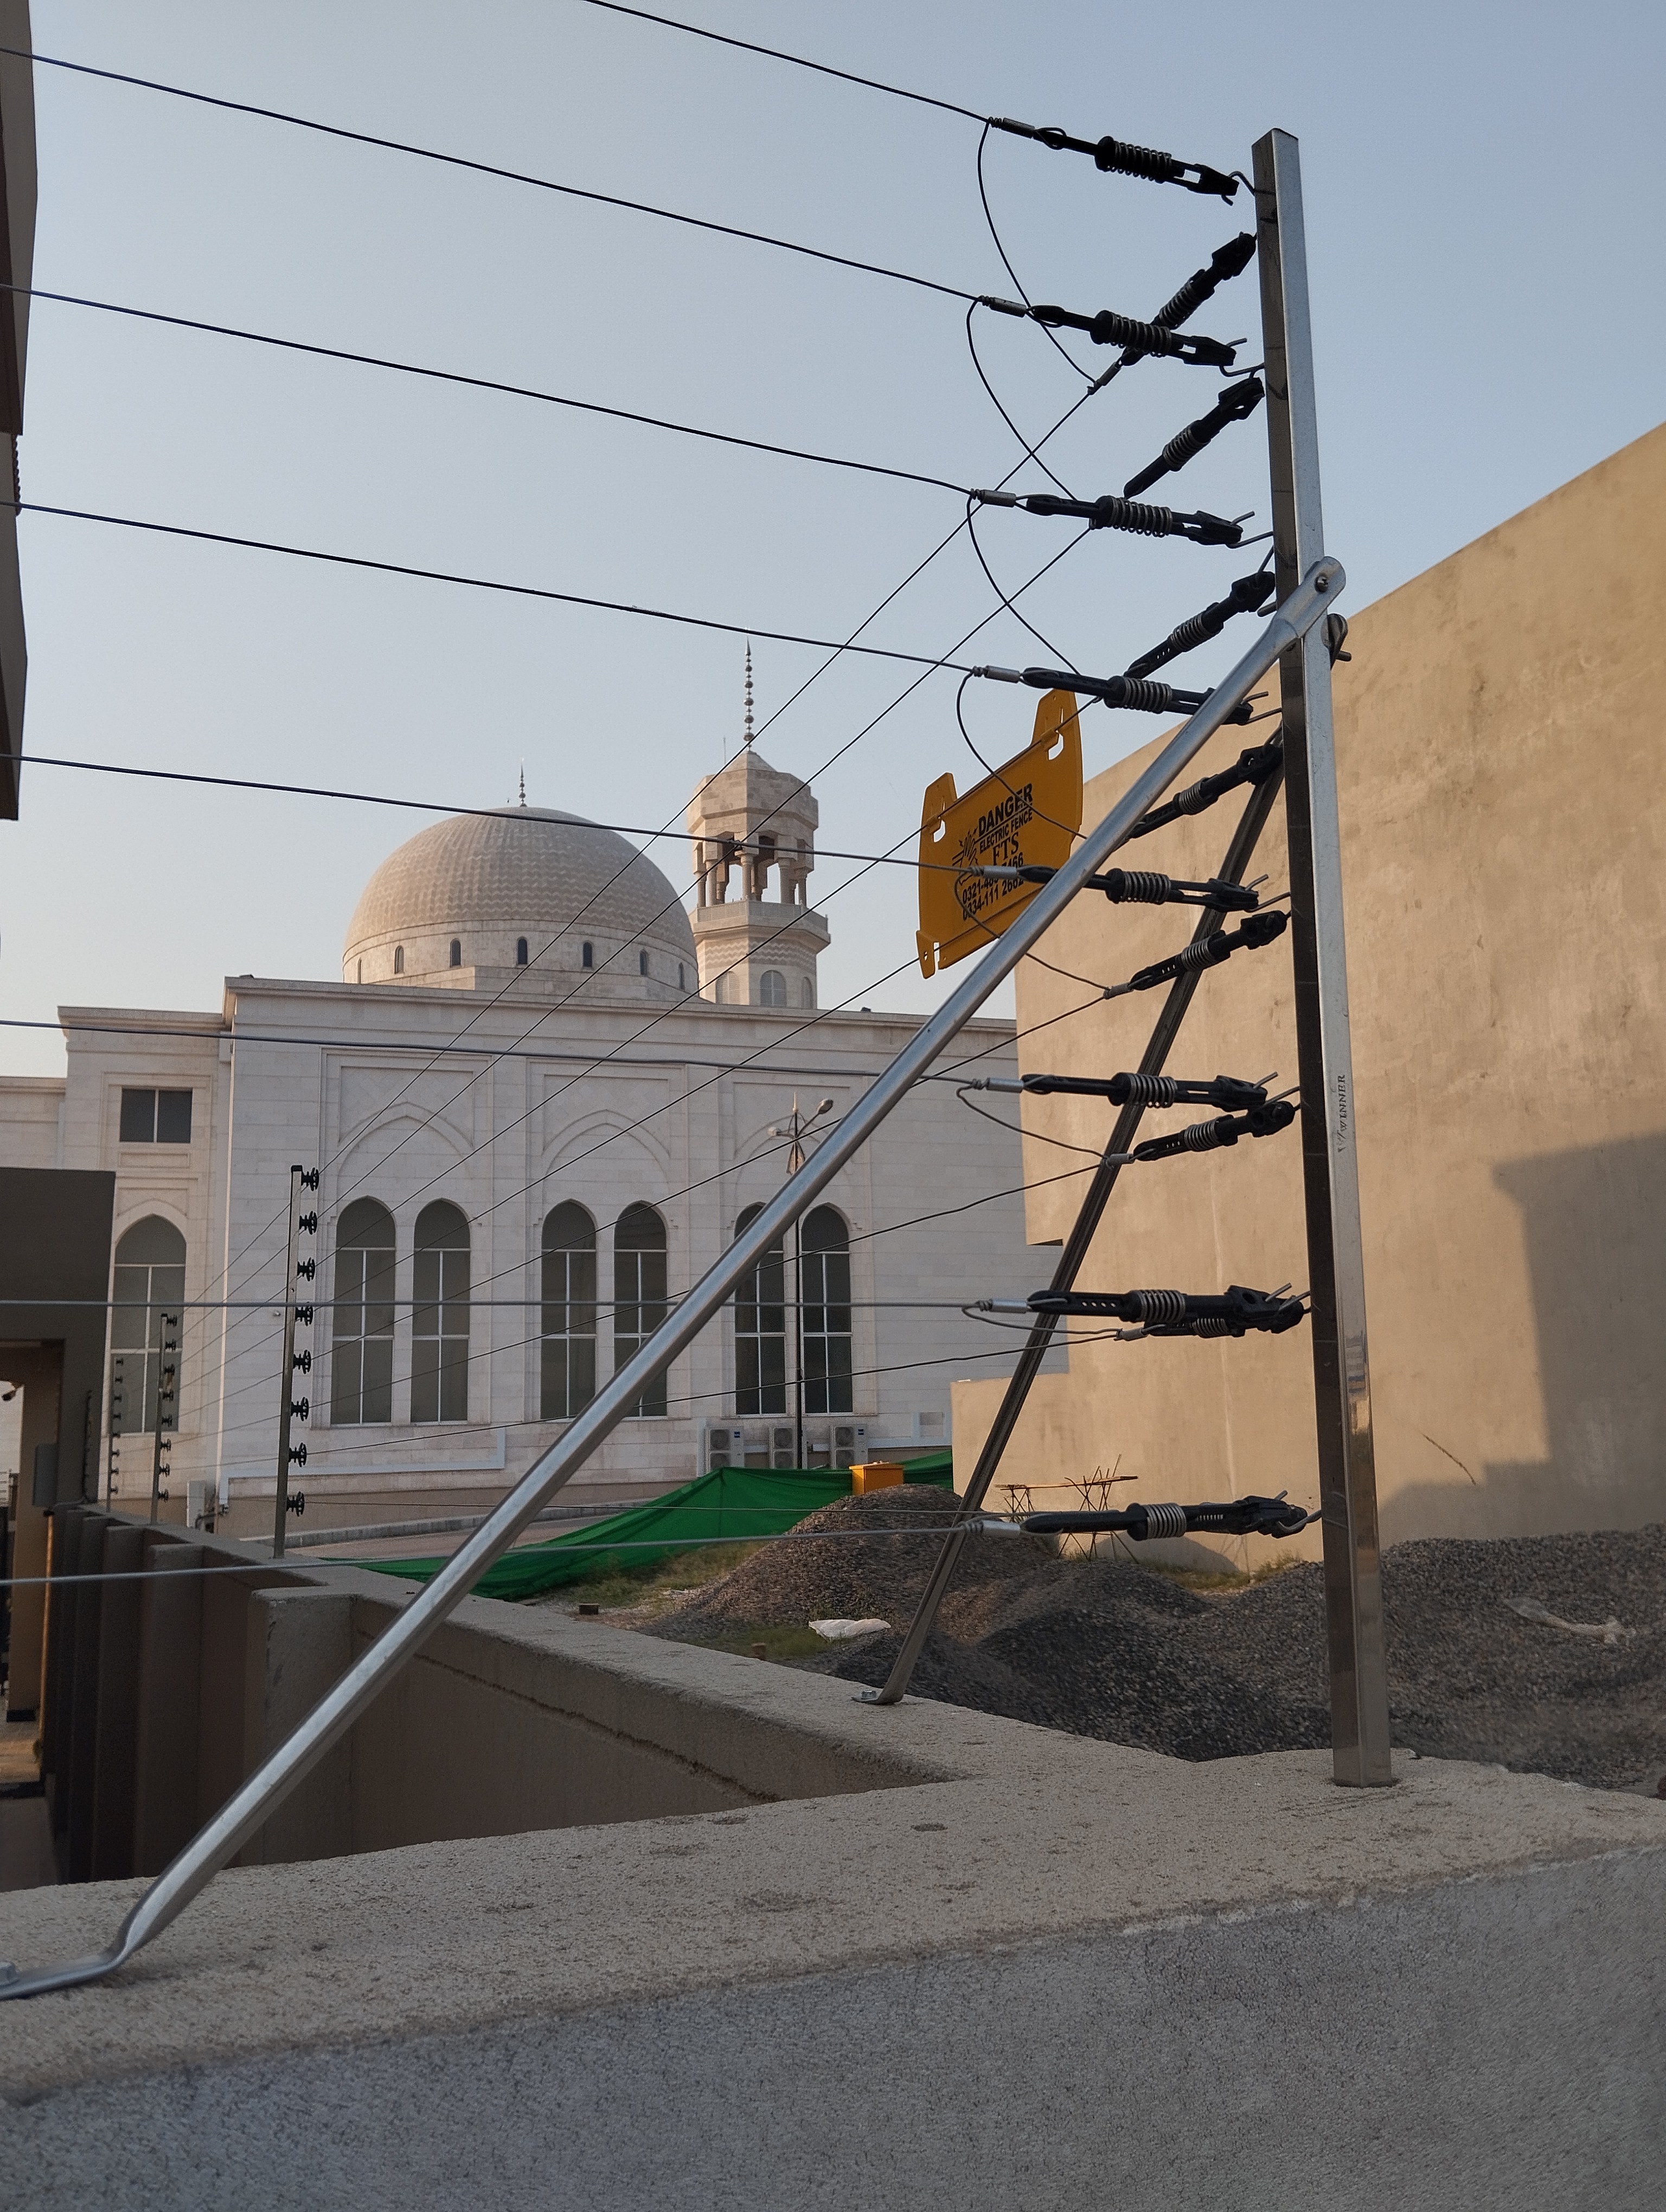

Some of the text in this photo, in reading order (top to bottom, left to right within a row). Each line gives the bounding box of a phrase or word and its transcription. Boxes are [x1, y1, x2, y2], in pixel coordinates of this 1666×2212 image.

[979, 783, 1033, 837] DANGER
[979, 809, 1033, 854] ELECTRIC FENCE
[992, 832, 1019, 866] FTS
